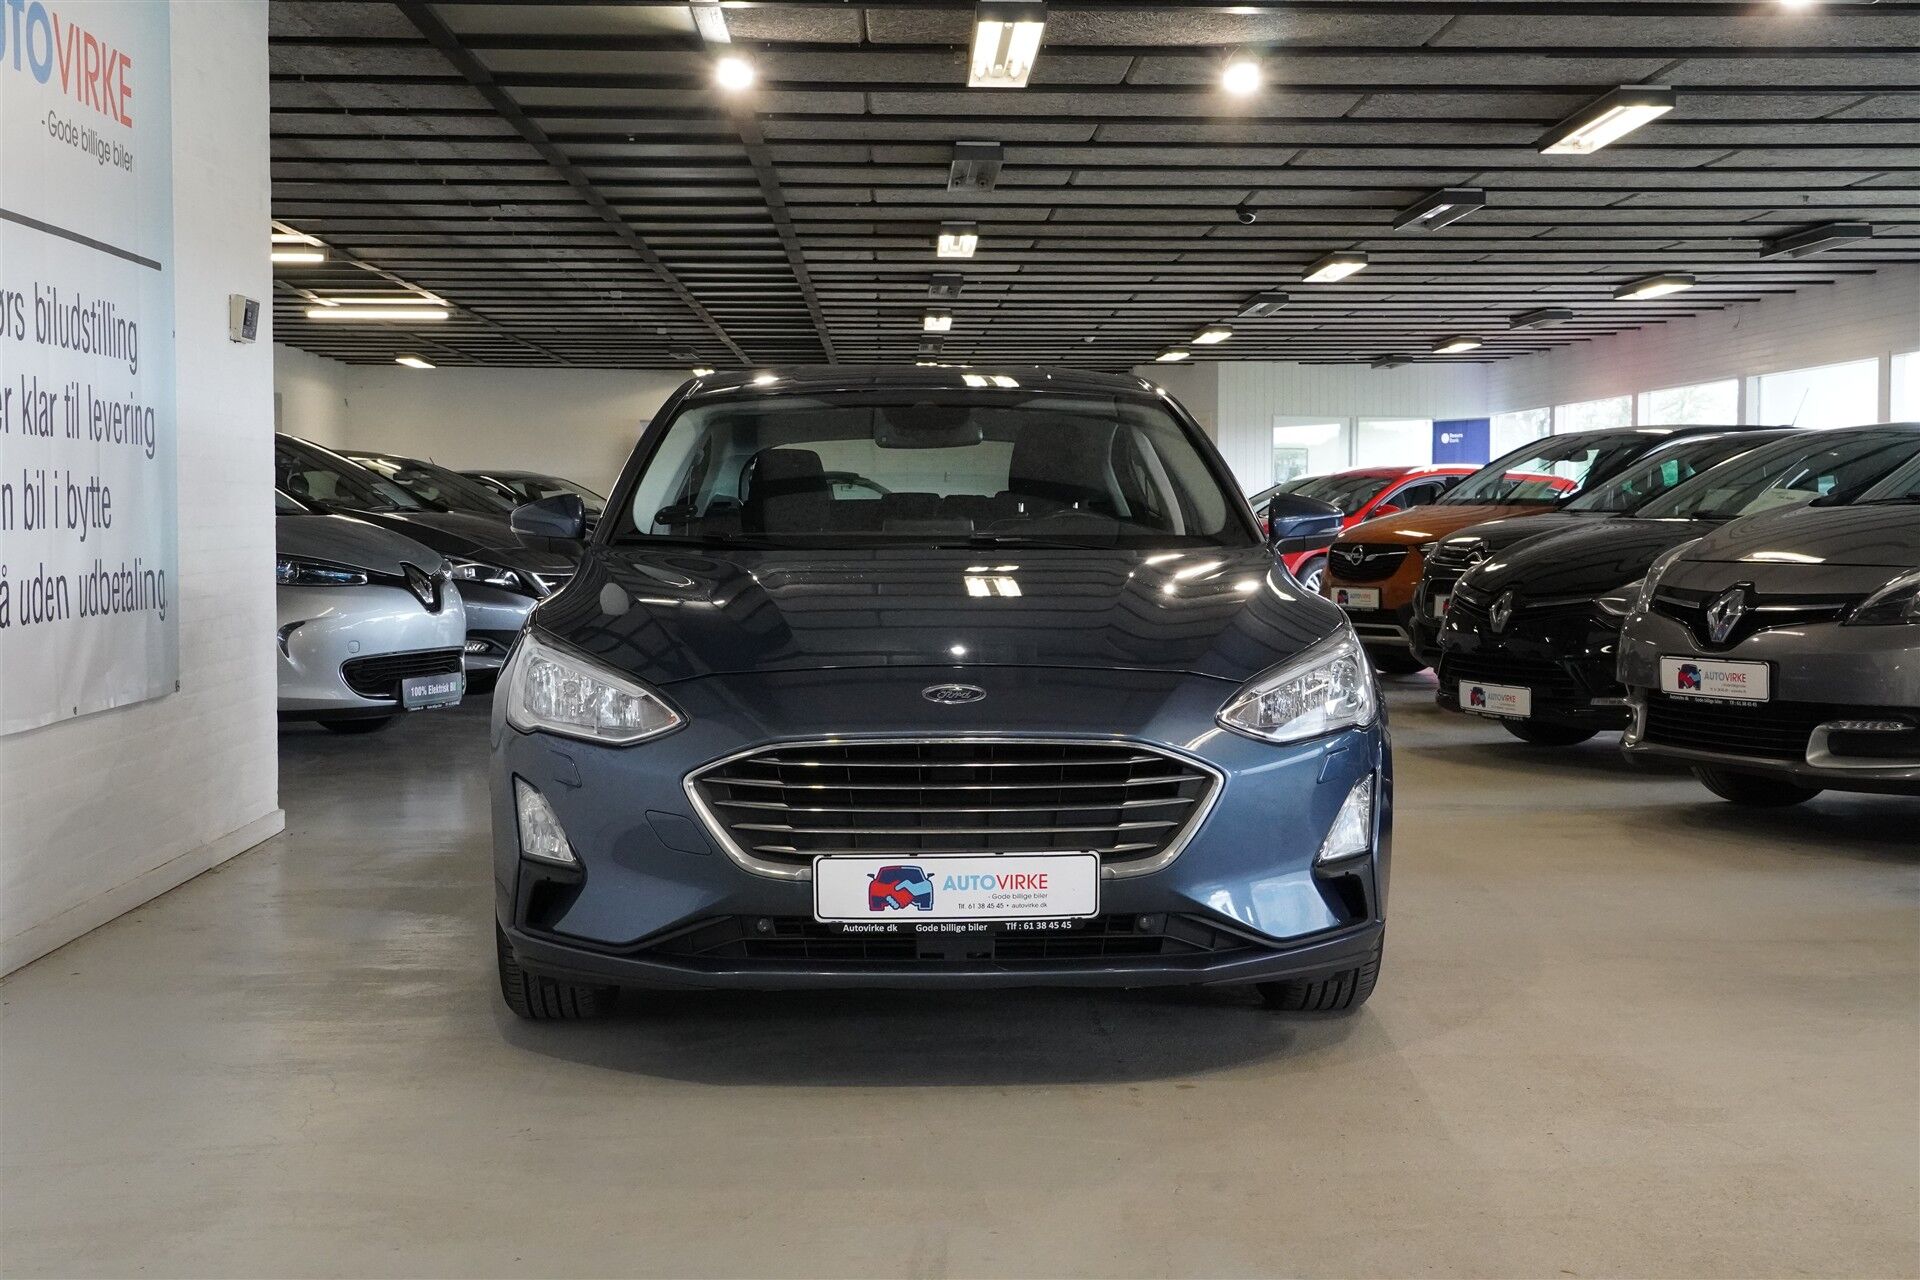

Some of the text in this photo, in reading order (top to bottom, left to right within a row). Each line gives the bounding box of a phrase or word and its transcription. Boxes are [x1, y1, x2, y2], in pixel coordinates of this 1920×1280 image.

[0, 0, 133, 128] TOVIRKE
[48, 110, 79, 147] Gode
[81, 125, 111, 165] billige
[113, 141, 133, 172] biler
[34, 281, 137, 374] biludstilling
[0, 374, 155, 459] r klar til levering
[24, 469, 46, 531] bil
[54, 471, 58, 529] i
[66, 471, 112, 541] bytte
[20, 562, 70, 625] uden
[411, 686, 427, 696] 100%
[937, 691, 972, 699] Ford
[1704, 671, 1747, 683] AUTOVIRKE
[943, 874, 1048, 891] AUTOVIRKE
[1012, 893, 1032, 901] billige
[915, 924, 939, 932] Gode
[940, 923, 967, 933] billige
[968, 923, 988, 931] biler
[1023, 922, 1034, 930] 61
[1036, 921, 1046, 930] 38
[1048, 921, 1059, 929] 45
[1060, 921, 1072, 929] 45
